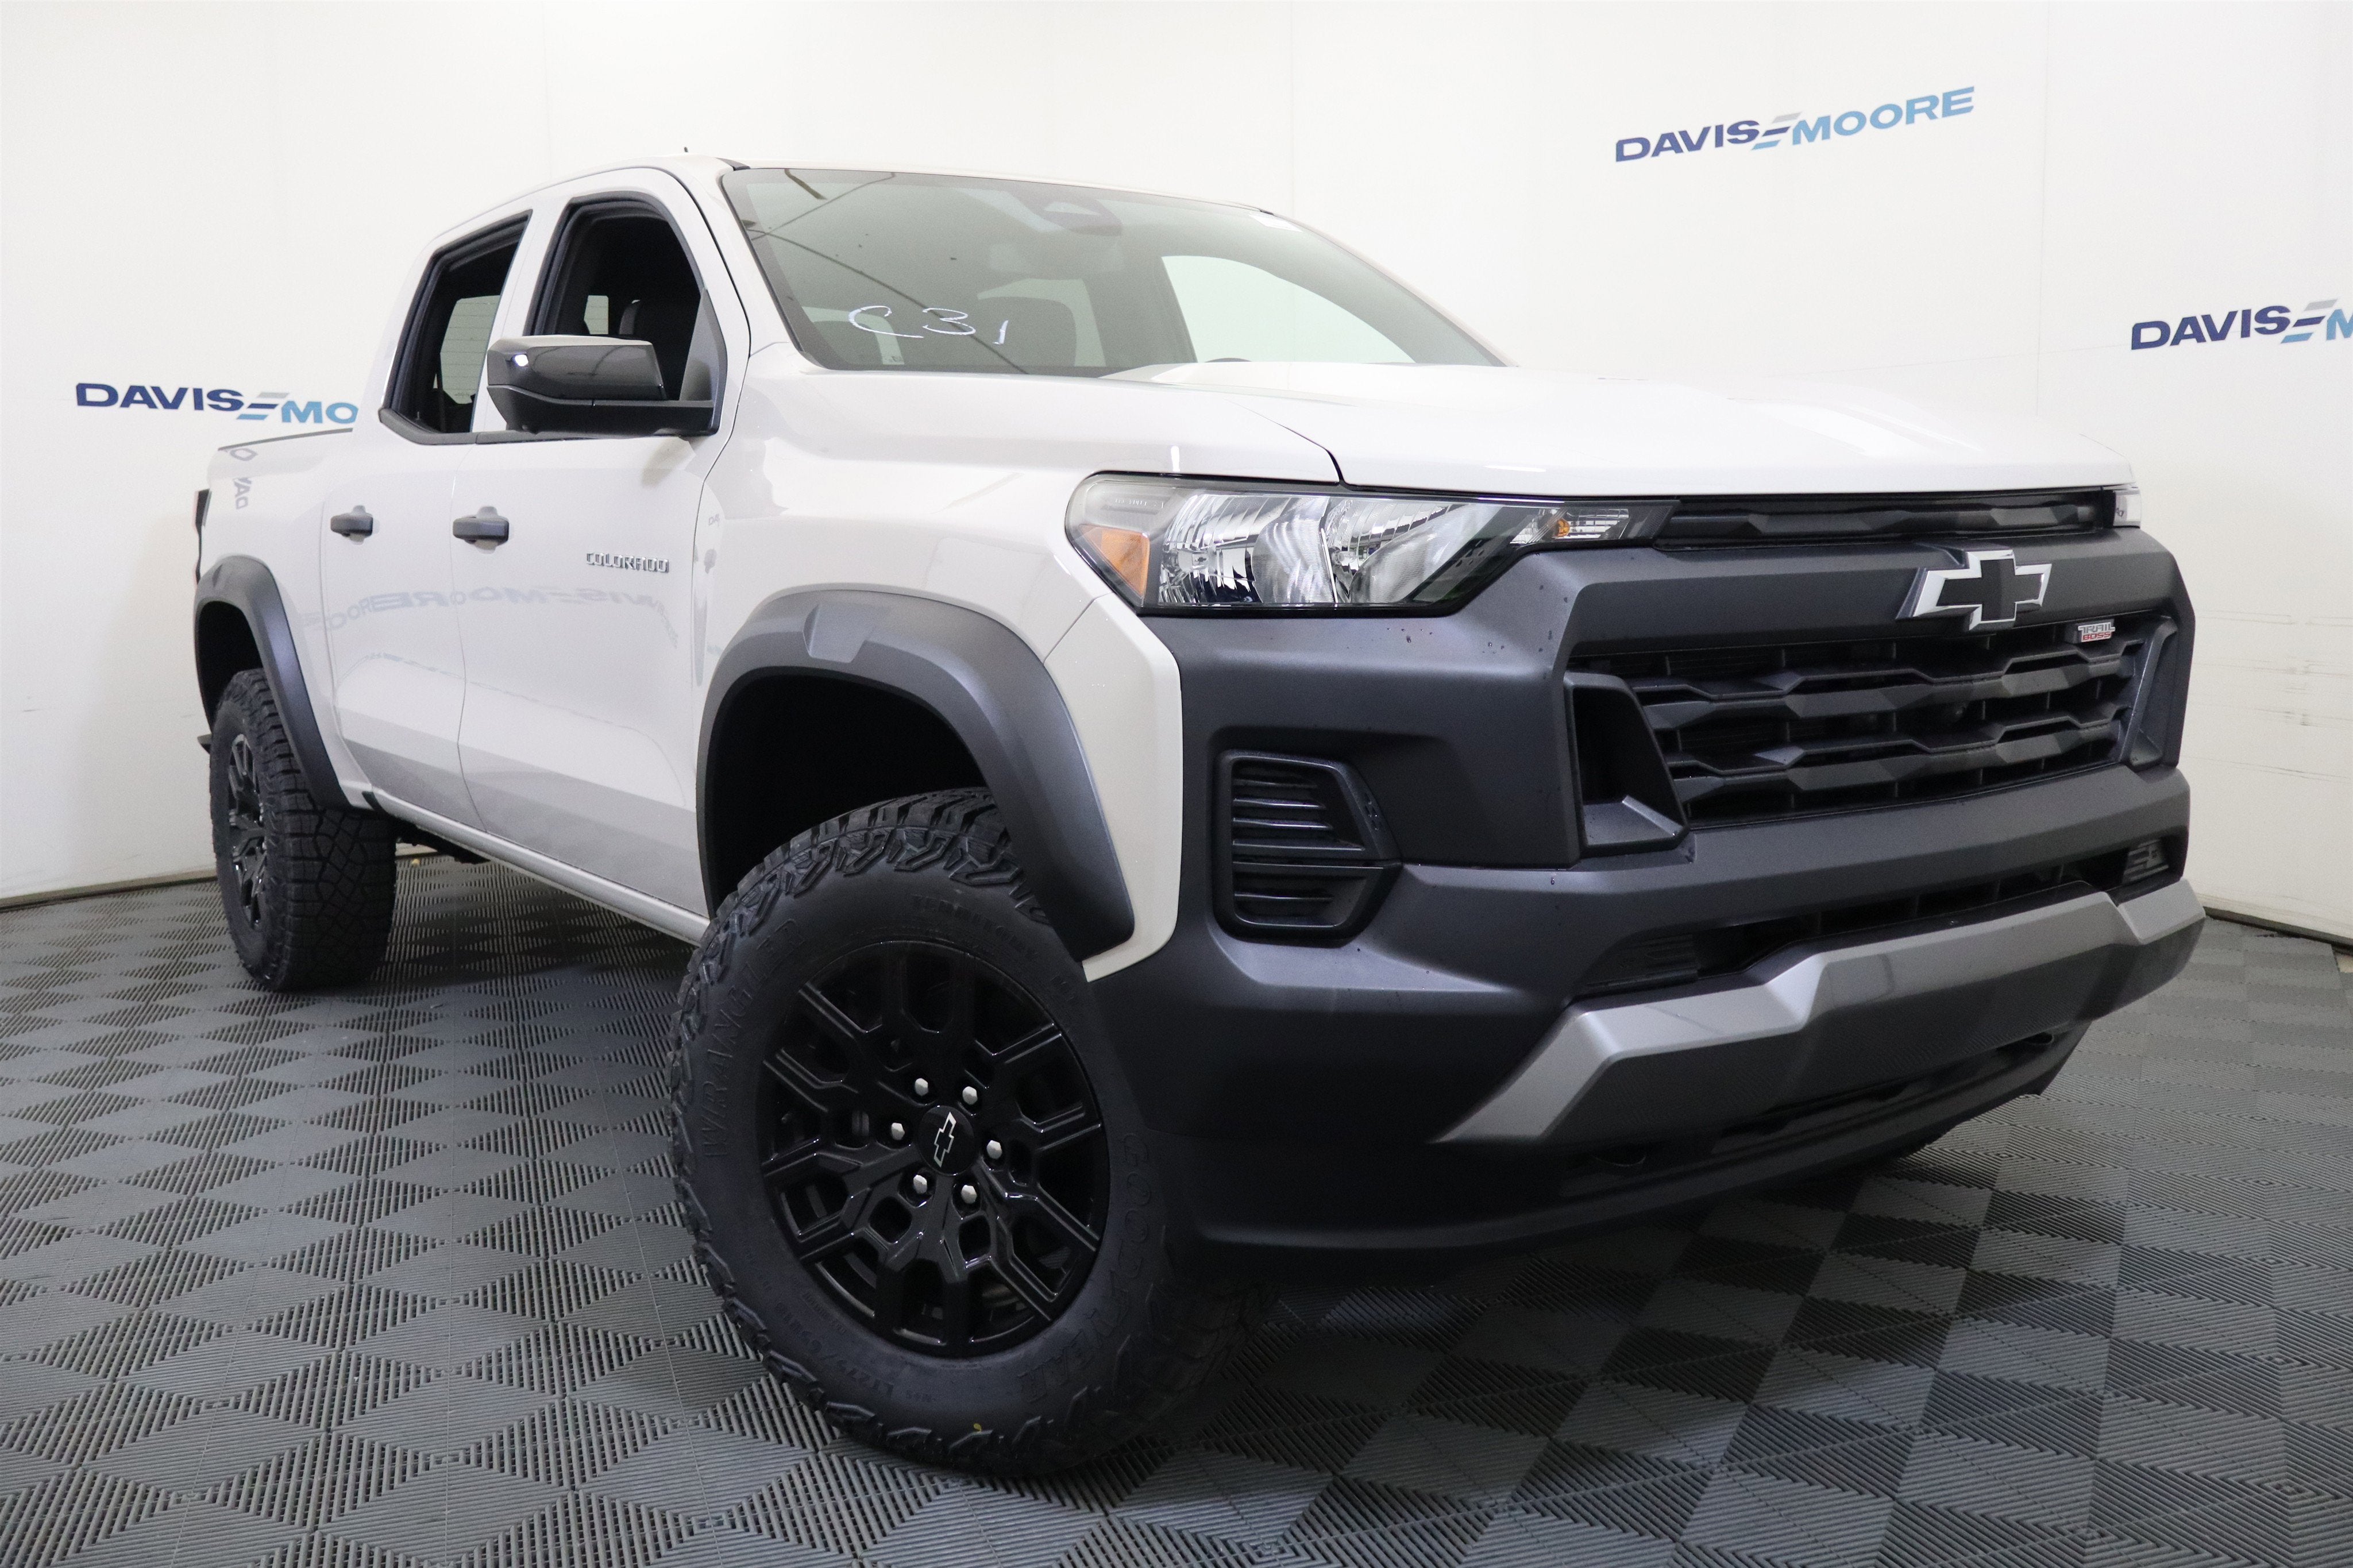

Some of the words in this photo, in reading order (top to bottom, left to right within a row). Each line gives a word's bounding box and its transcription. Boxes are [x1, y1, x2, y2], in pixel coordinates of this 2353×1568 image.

[1615, 119, 1760, 163] DAVIS
[1792, 86, 1975, 146] MOORE
[2131, 305, 2292, 350] DAVIS
[75, 382, 245, 412] DAVIS
[281, 400, 359, 424] MO
[586, 551, 669, 573] COLORADO
[2077, 621, 2116, 634] TRAIL
[2082, 631, 2112, 642] BOSS
[701, 917, 805, 1158] WRANGLER
